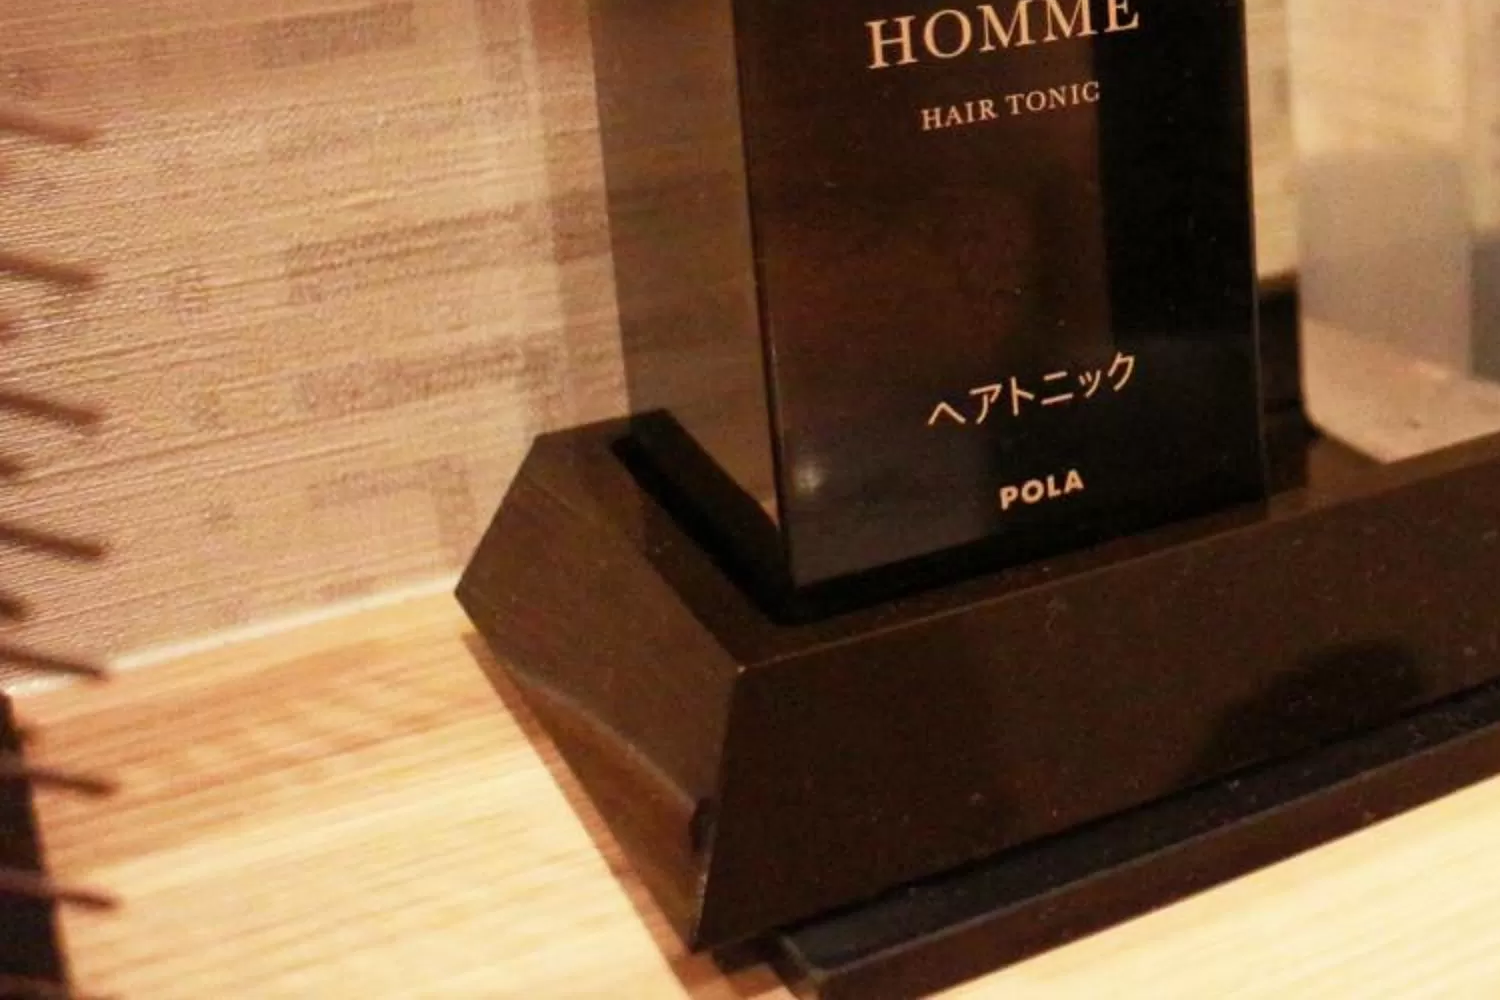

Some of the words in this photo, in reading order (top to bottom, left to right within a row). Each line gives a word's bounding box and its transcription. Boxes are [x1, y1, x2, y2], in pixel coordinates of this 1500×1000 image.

[920, 98, 998, 131] HAIR
[1005, 80, 1101, 116] TONIC
[927, 351, 1137, 427] ヘアトニック
[999, 468, 1085, 511] POLA
